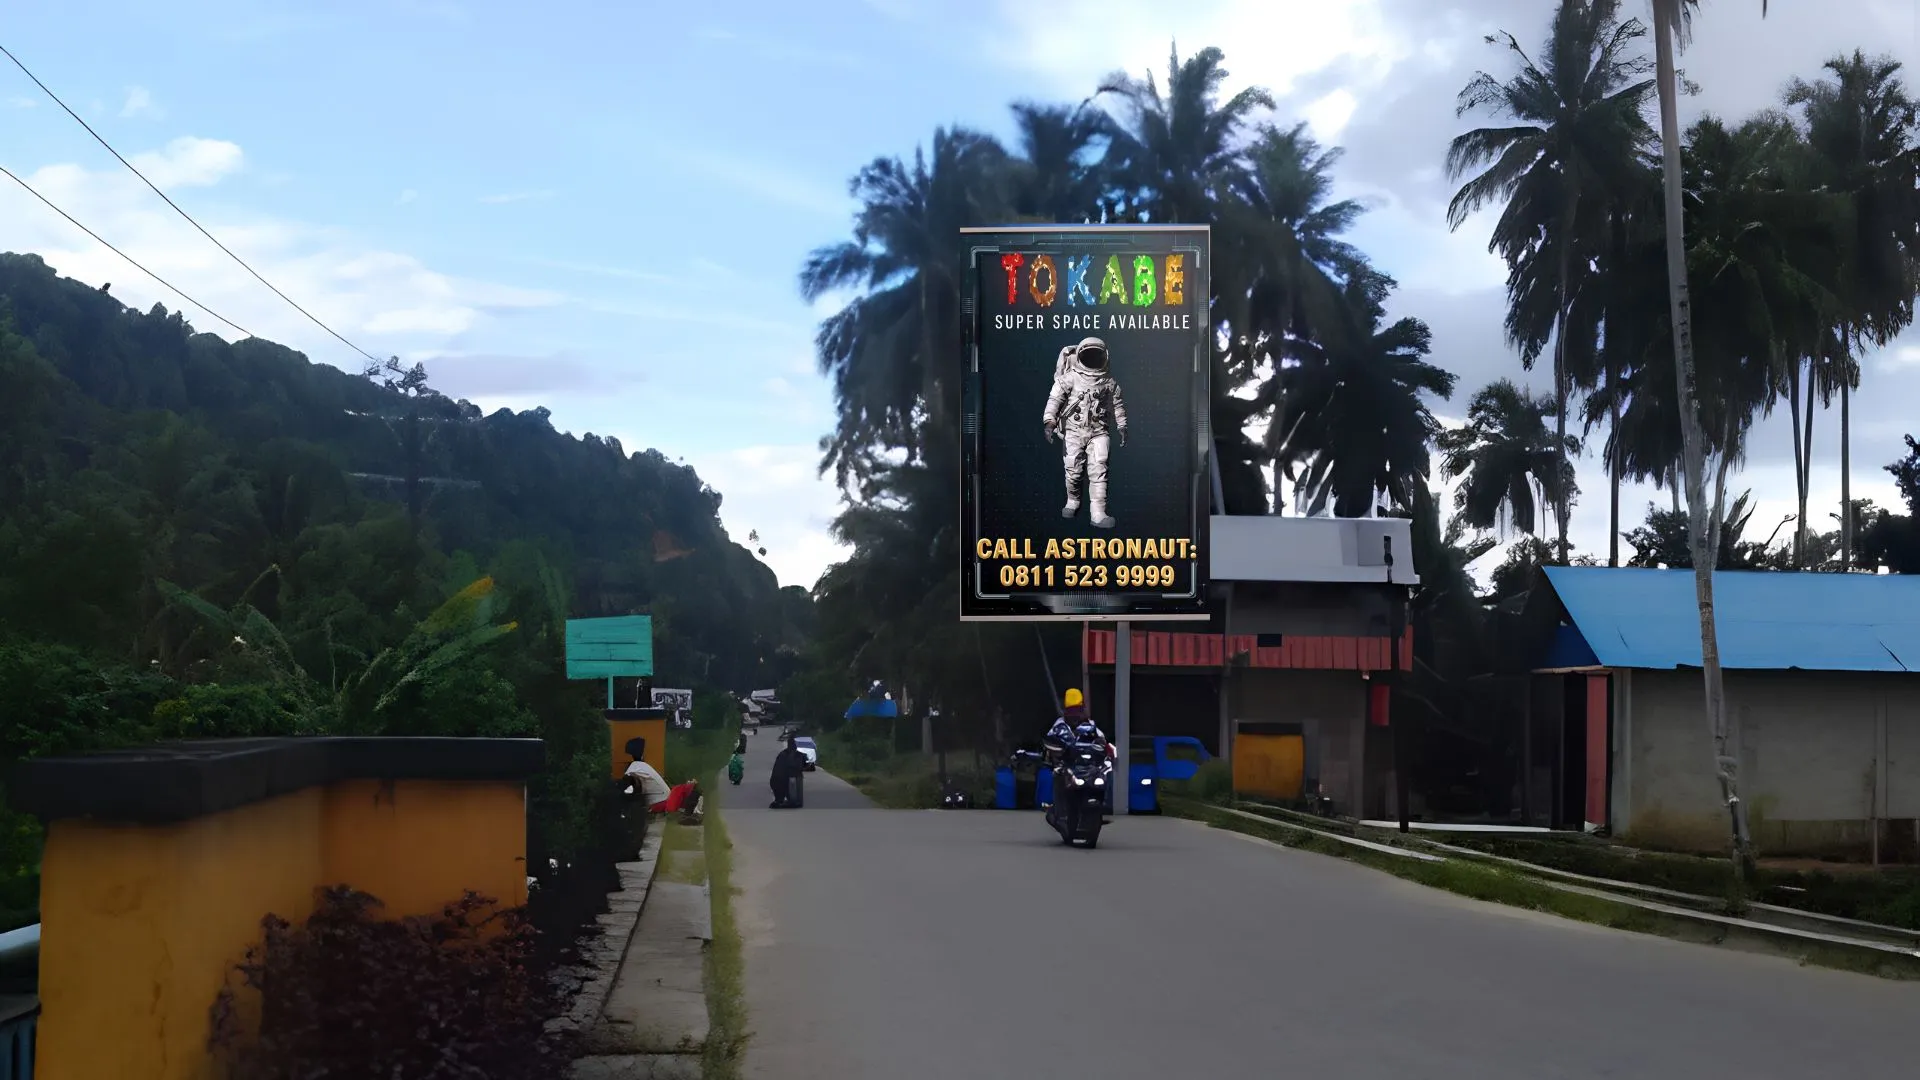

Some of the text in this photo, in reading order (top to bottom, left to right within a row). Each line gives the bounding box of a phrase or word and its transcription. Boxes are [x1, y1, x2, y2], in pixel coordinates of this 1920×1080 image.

[1001, 252, 1185, 307] TOKABE
[995, 314, 1190, 329] SUPER SPACE AVAILABLE
[976, 538, 1197, 559] CALL ASTRONAUT:
[1000, 565, 1175, 587] 0811 523 9999
